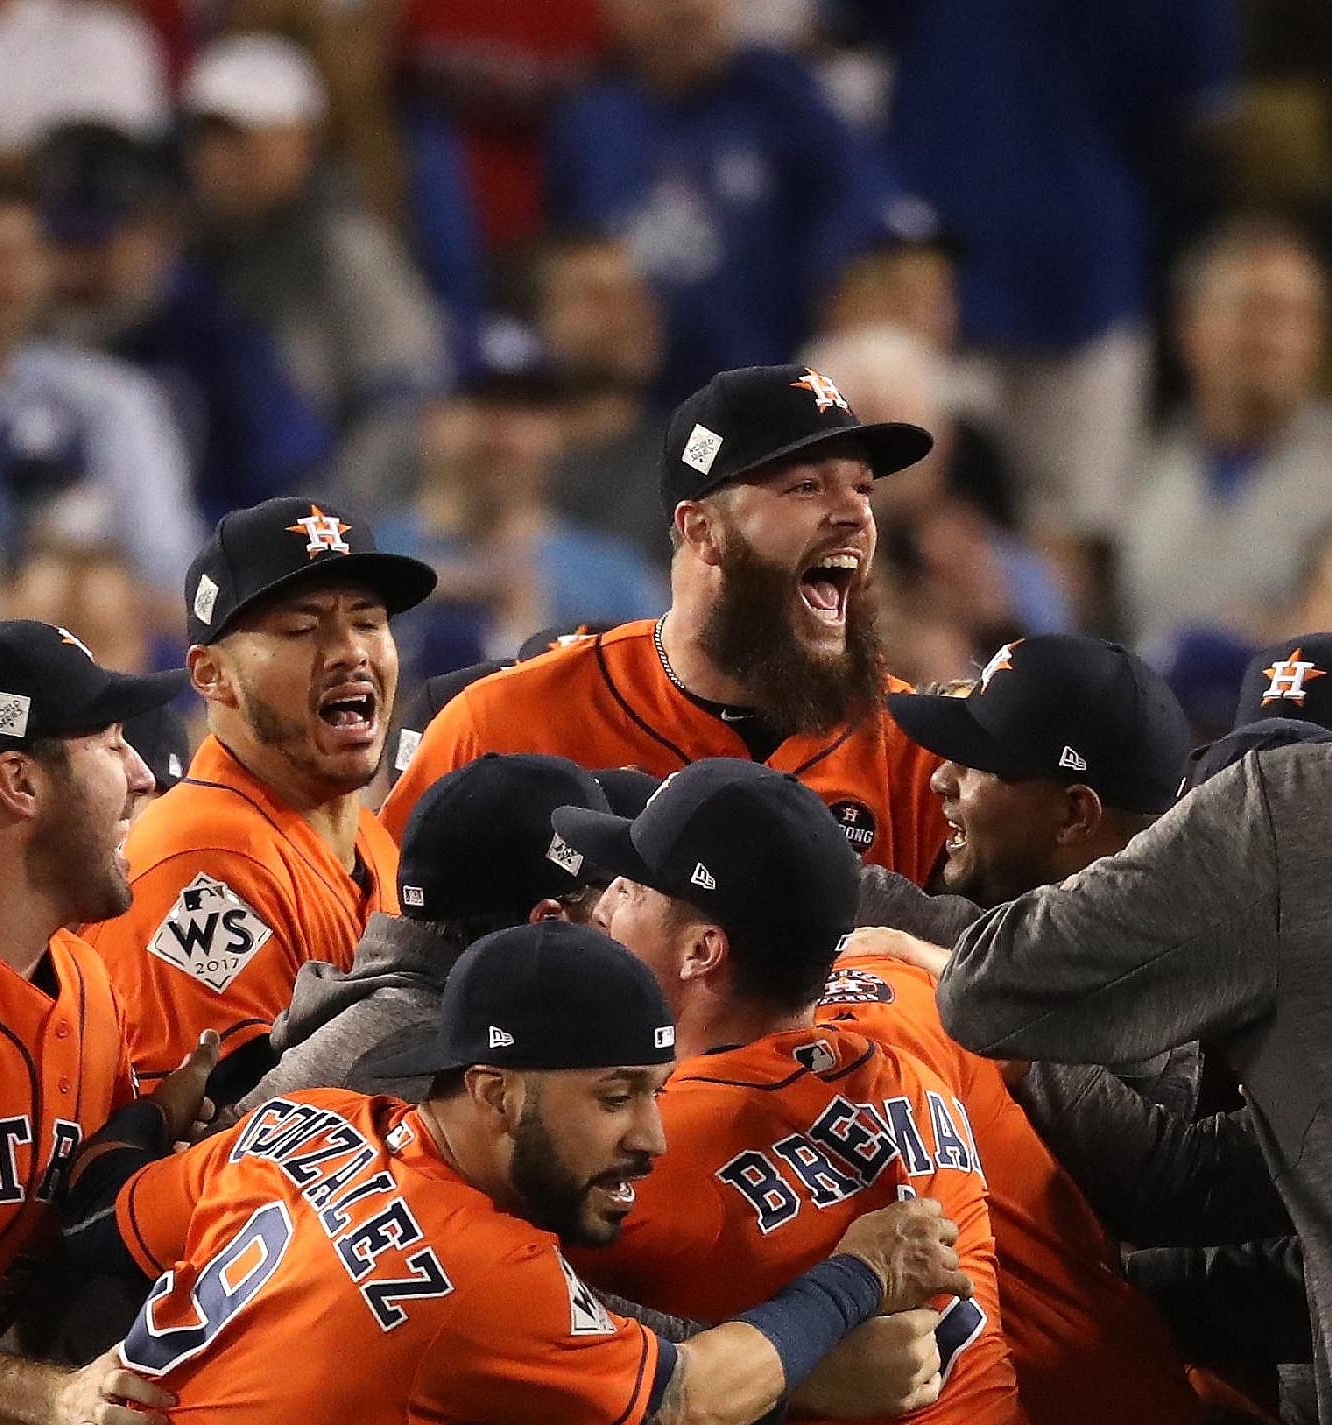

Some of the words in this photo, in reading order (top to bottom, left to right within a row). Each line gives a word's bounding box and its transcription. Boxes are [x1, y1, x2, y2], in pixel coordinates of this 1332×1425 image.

[296, 515, 351, 552] H
[1261, 660, 1316, 699] H
[167, 908, 255, 959] WS
[195, 957, 239, 975] 2017
[229, 1096, 455, 1333] GONZALEZ
[118, 1200, 295, 1377] 9
